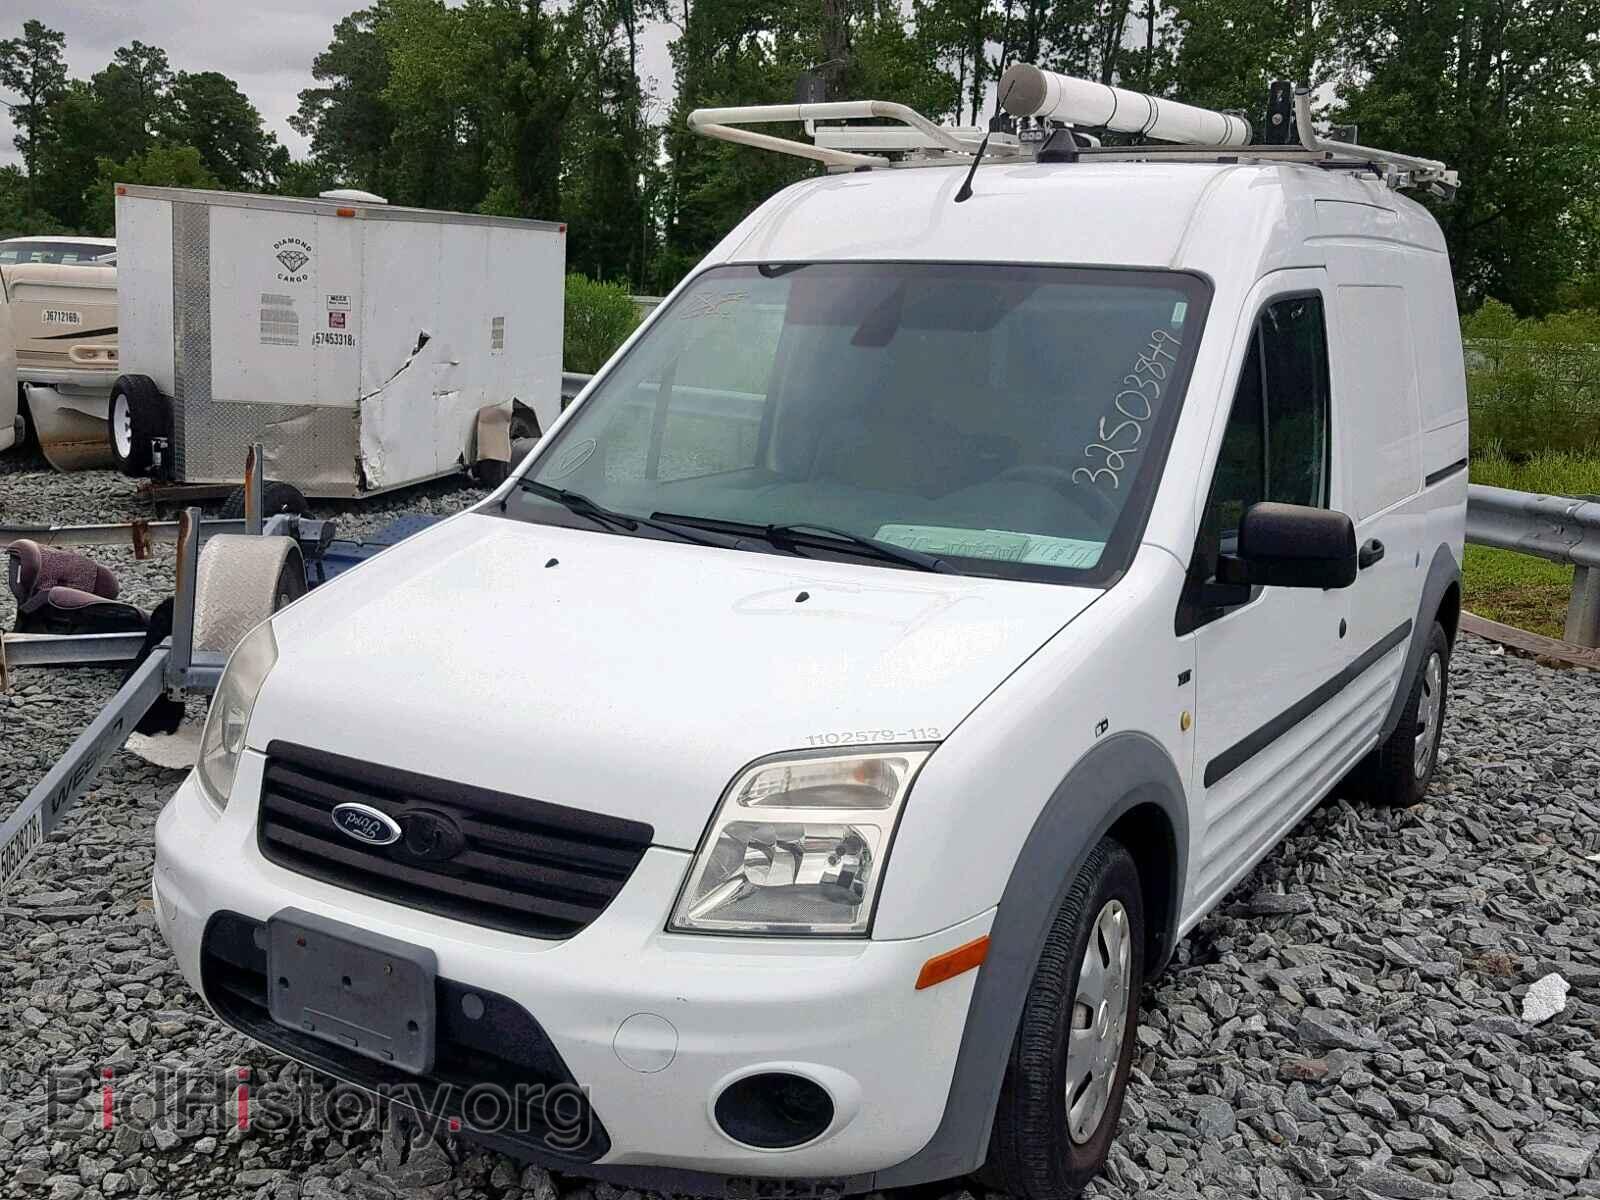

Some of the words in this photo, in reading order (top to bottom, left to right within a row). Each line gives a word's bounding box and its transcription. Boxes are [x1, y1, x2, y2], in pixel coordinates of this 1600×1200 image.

[273, 237, 312, 252] DIAMOND
[277, 273, 308, 283] CARGO
[315, 332, 353, 346] 57453318
[1072, 329, 1183, 489] 32503849
[806, 727, 942, 746] 1102579-113
